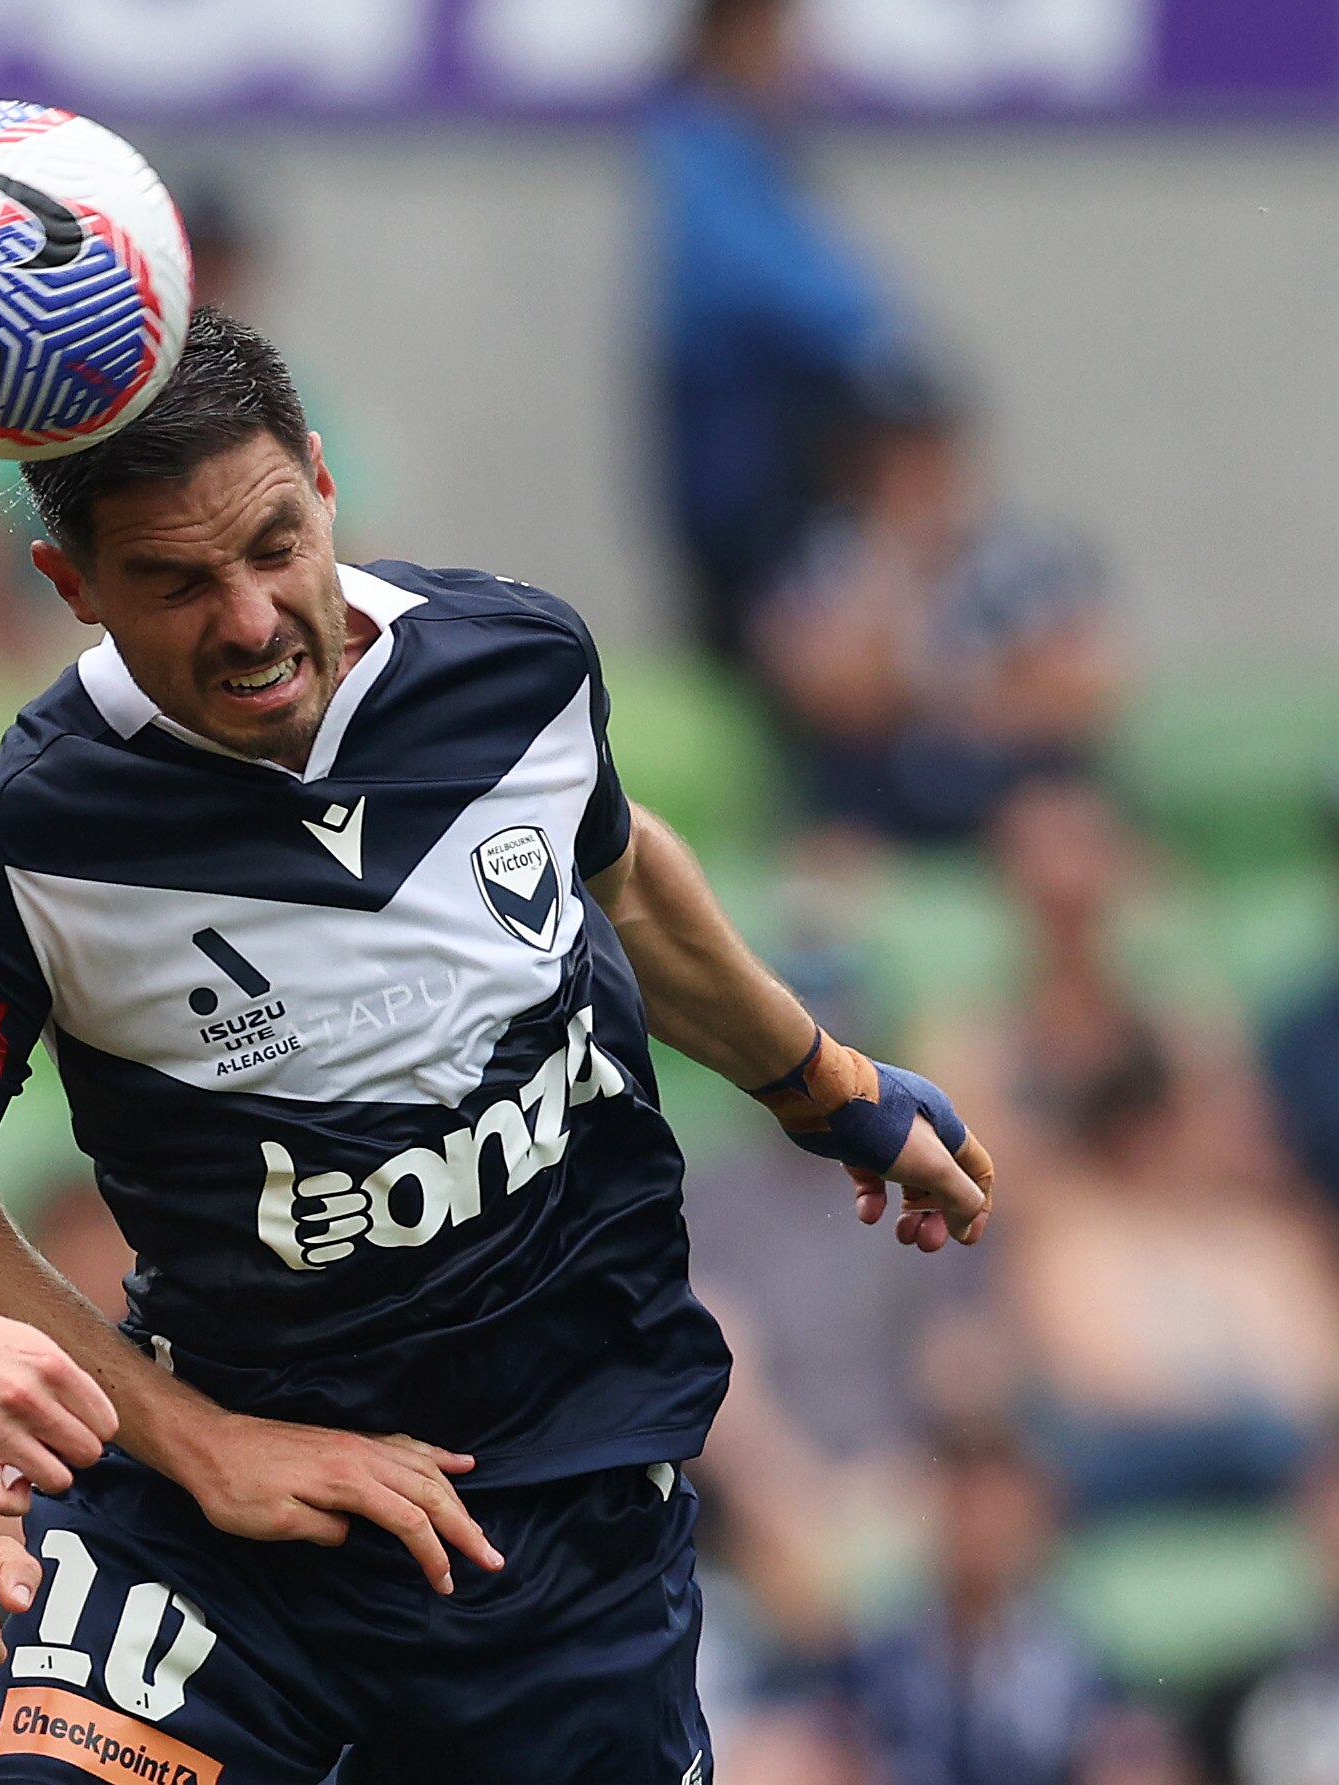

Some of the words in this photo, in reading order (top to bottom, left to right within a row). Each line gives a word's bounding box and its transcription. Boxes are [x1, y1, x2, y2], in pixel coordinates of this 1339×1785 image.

[487, 834, 536, 857] MELBOURNE
[489, 849, 542, 876] Victory
[200, 1001, 286, 1044] ISUZU
[225, 1025, 276, 1051] UTE
[216, 1035, 301, 1077] A-LEAGUE
[11, 1529, 217, 1722] 10
[13, 1706, 171, 1785] Checkpoint
